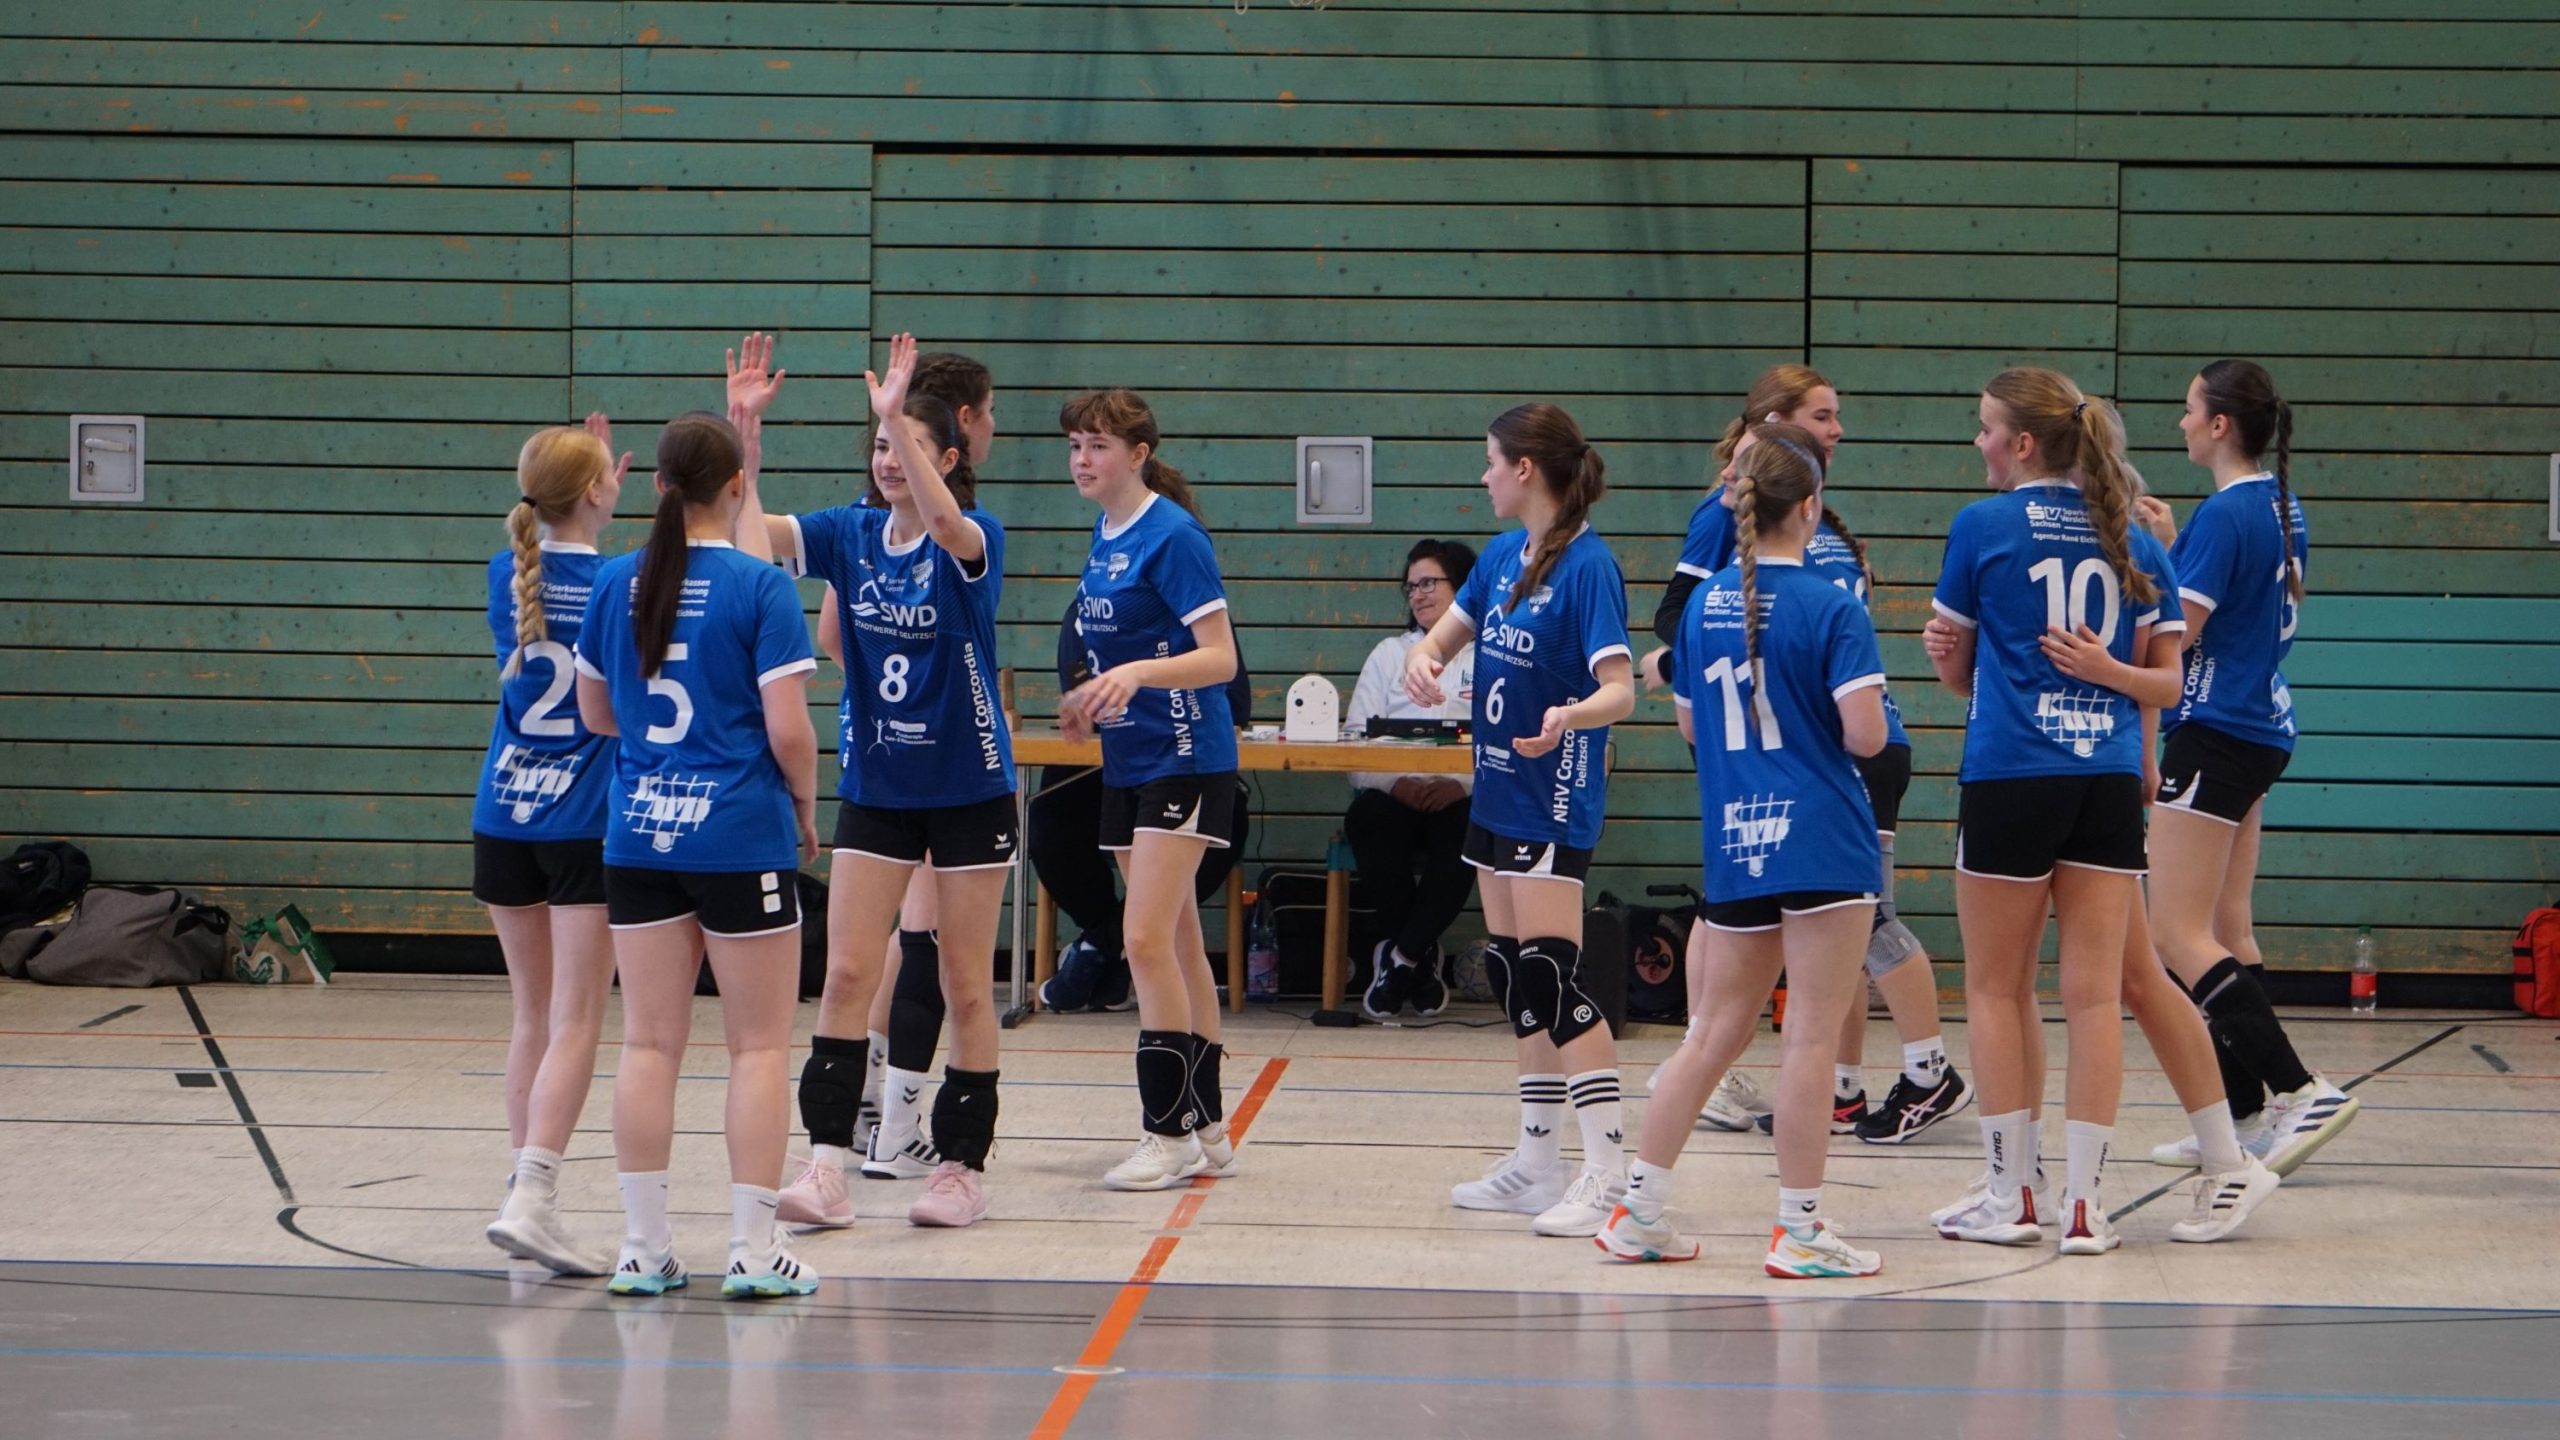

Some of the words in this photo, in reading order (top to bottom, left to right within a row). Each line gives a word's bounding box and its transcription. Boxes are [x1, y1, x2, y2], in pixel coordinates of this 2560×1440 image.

[2029, 520, 2061, 528] Sachsen
[2032, 532, 2060, 541] Agentur
[879, 601, 937, 627] SWD
[1084, 595, 1114, 620] SWD
[2028, 558, 2121, 650] 10
[854, 618, 898, 637] STADTWERKE
[1496, 623, 1535, 654] SWD
[519, 640, 577, 737] 2
[644, 643, 694, 744] 5
[878, 653, 910, 703] 8
[964, 641, 990, 728] Concordia
[2196, 656, 2216, 703] Delitzsch
[1187, 688, 1202, 721] Delitz
[1485, 677, 1506, 726] 6
[1703, 656, 1784, 752] 11
[2178, 699, 2193, 721] HV
[978, 731, 1000, 771] NHV
[1174, 722, 1193, 757] NHV
[1575, 735, 1590, 788] Delitzsch
[1553, 783, 1571, 823] NHV
[1992, 1130, 2003, 1162] CRAFT
